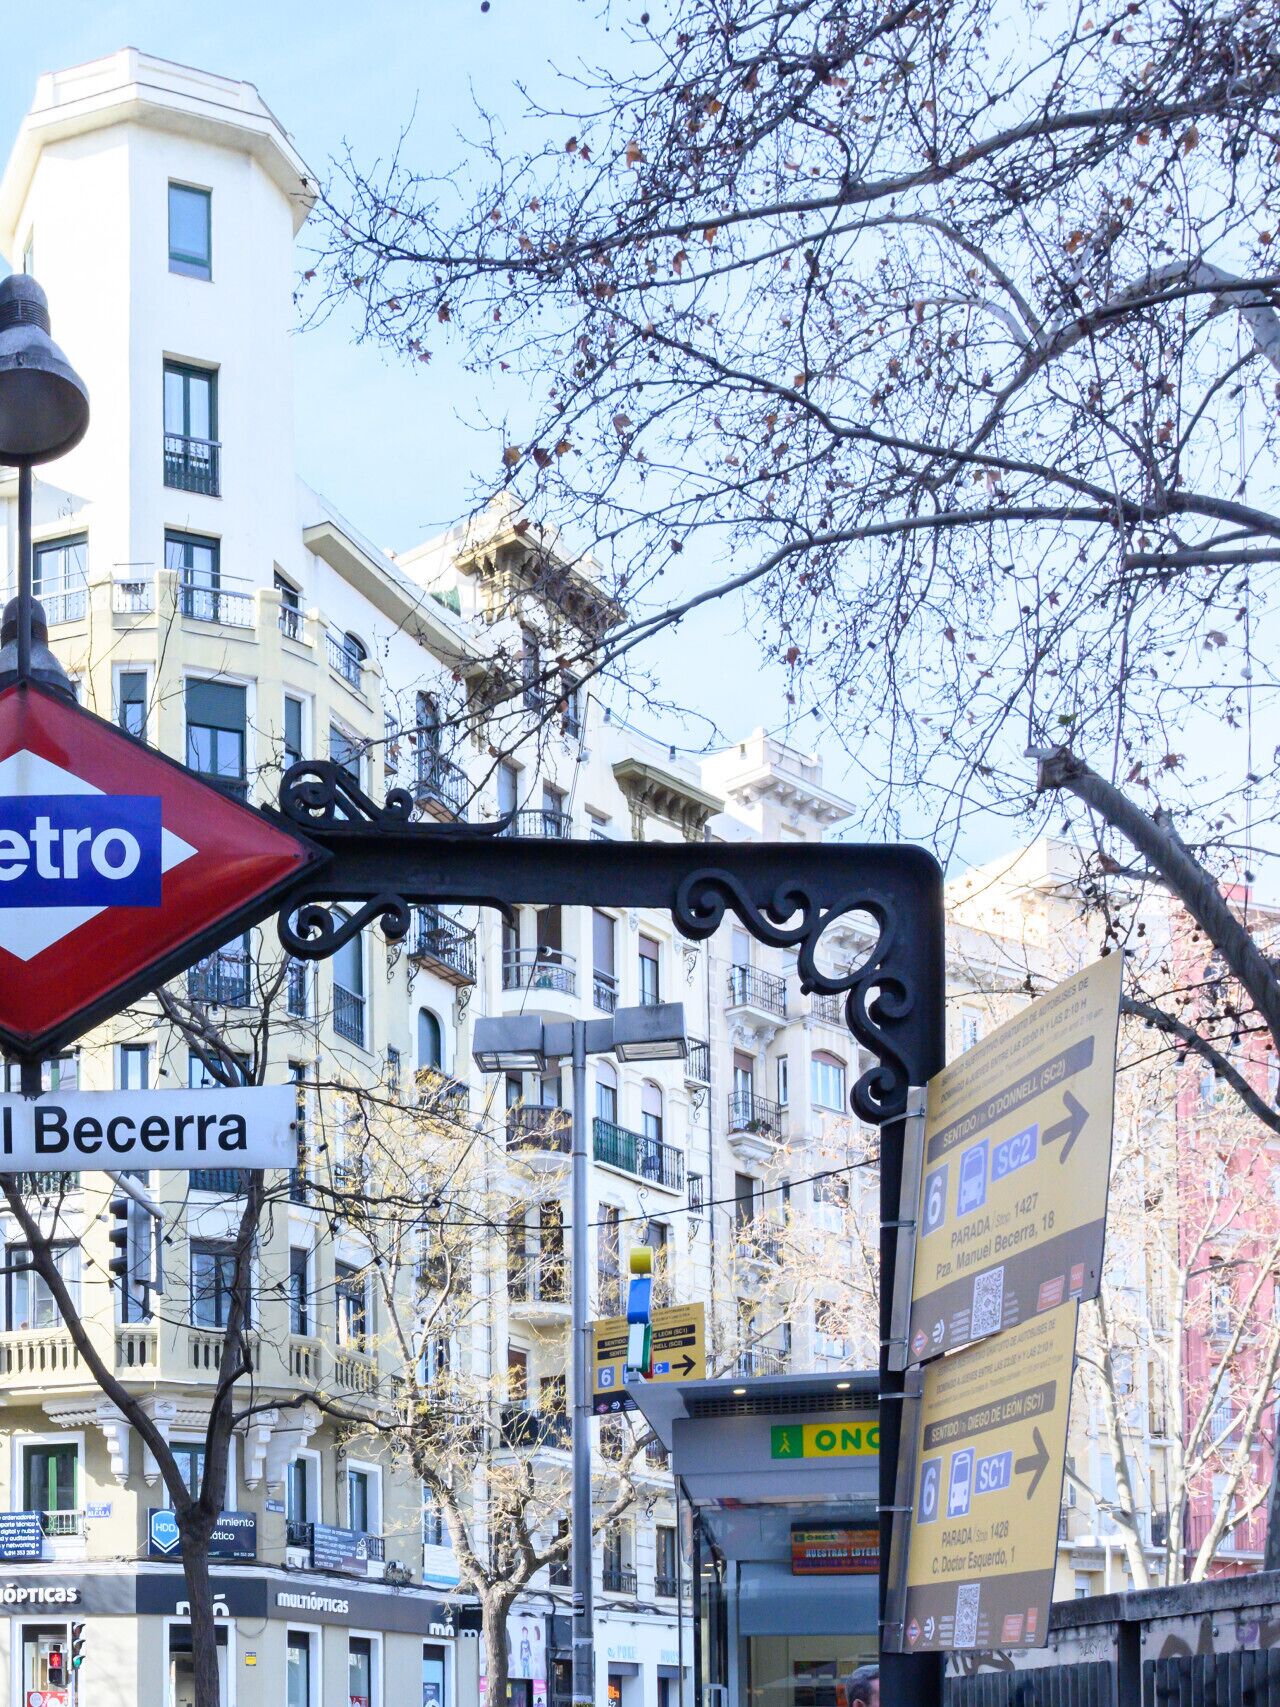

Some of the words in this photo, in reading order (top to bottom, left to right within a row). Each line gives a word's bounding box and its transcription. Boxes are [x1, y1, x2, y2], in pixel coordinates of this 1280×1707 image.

[999, 1015, 1028, 1045] GRATUITO
[1029, 1008, 1038, 1024] DE
[1039, 982, 1076, 1018] AUTOBUSES
[1078, 974, 1088, 993] DE
[990, 1048, 1008, 1069] ENTRE
[1009, 1039, 1021, 1056] LAS
[1050, 1011, 1062, 1029] LAS
[1064, 1000, 1079, 1020] 2:10
[942, 1112, 976, 1148] SENTIDO
[987, 1075, 1038, 1120] O'DONNELL
[1040, 1056, 1066, 1089] (SC2)
[33, 1106, 247, 1154] Becerra
[997, 1130, 1031, 1176] SC2
[927, 1172, 942, 1227] 6
[950, 1214, 991, 1250] PARADA
[1013, 1191, 1038, 1219] 1427
[935, 1257, 953, 1280] Pza.
[956, 1238, 992, 1271] Manuel
[993, 1217, 1038, 1256] Becerra,
[1041, 1209, 1054, 1232] 18
[1009, 1335, 1016, 1347] DE
[1017, 1321, 1047, 1344] AUTOBUSES
[1048, 1317, 1056, 1331] DE
[601, 1369, 611, 1385] 6
[978, 1362, 992, 1377] ENTRE
[993, 1359, 1003, 1372] LAS
[1027, 1345, 1036, 1359] LAS
[931, 1419, 959, 1442] SENTIDO
[967, 1409, 990, 1431] DIEGO
[991, 1405, 1000, 1423] DE
[1002, 1395, 1022, 1420] LEÓN
[1022, 1389, 1044, 1414] (SC1)
[921, 1464, 936, 1517] 6
[978, 1455, 1006, 1491] SC1
[155, 1523, 176, 1532] HDD
[210, 1531, 235, 1540] ático
[941, 1526, 972, 1548] PARADA
[989, 1519, 1009, 1540] 1428
[806, 1548, 848, 1557] NUESTRAS
[931, 1557, 940, 1573] C.
[941, 1552, 965, 1573] Doctor
[968, 1545, 1008, 1574] Esquerdo,
